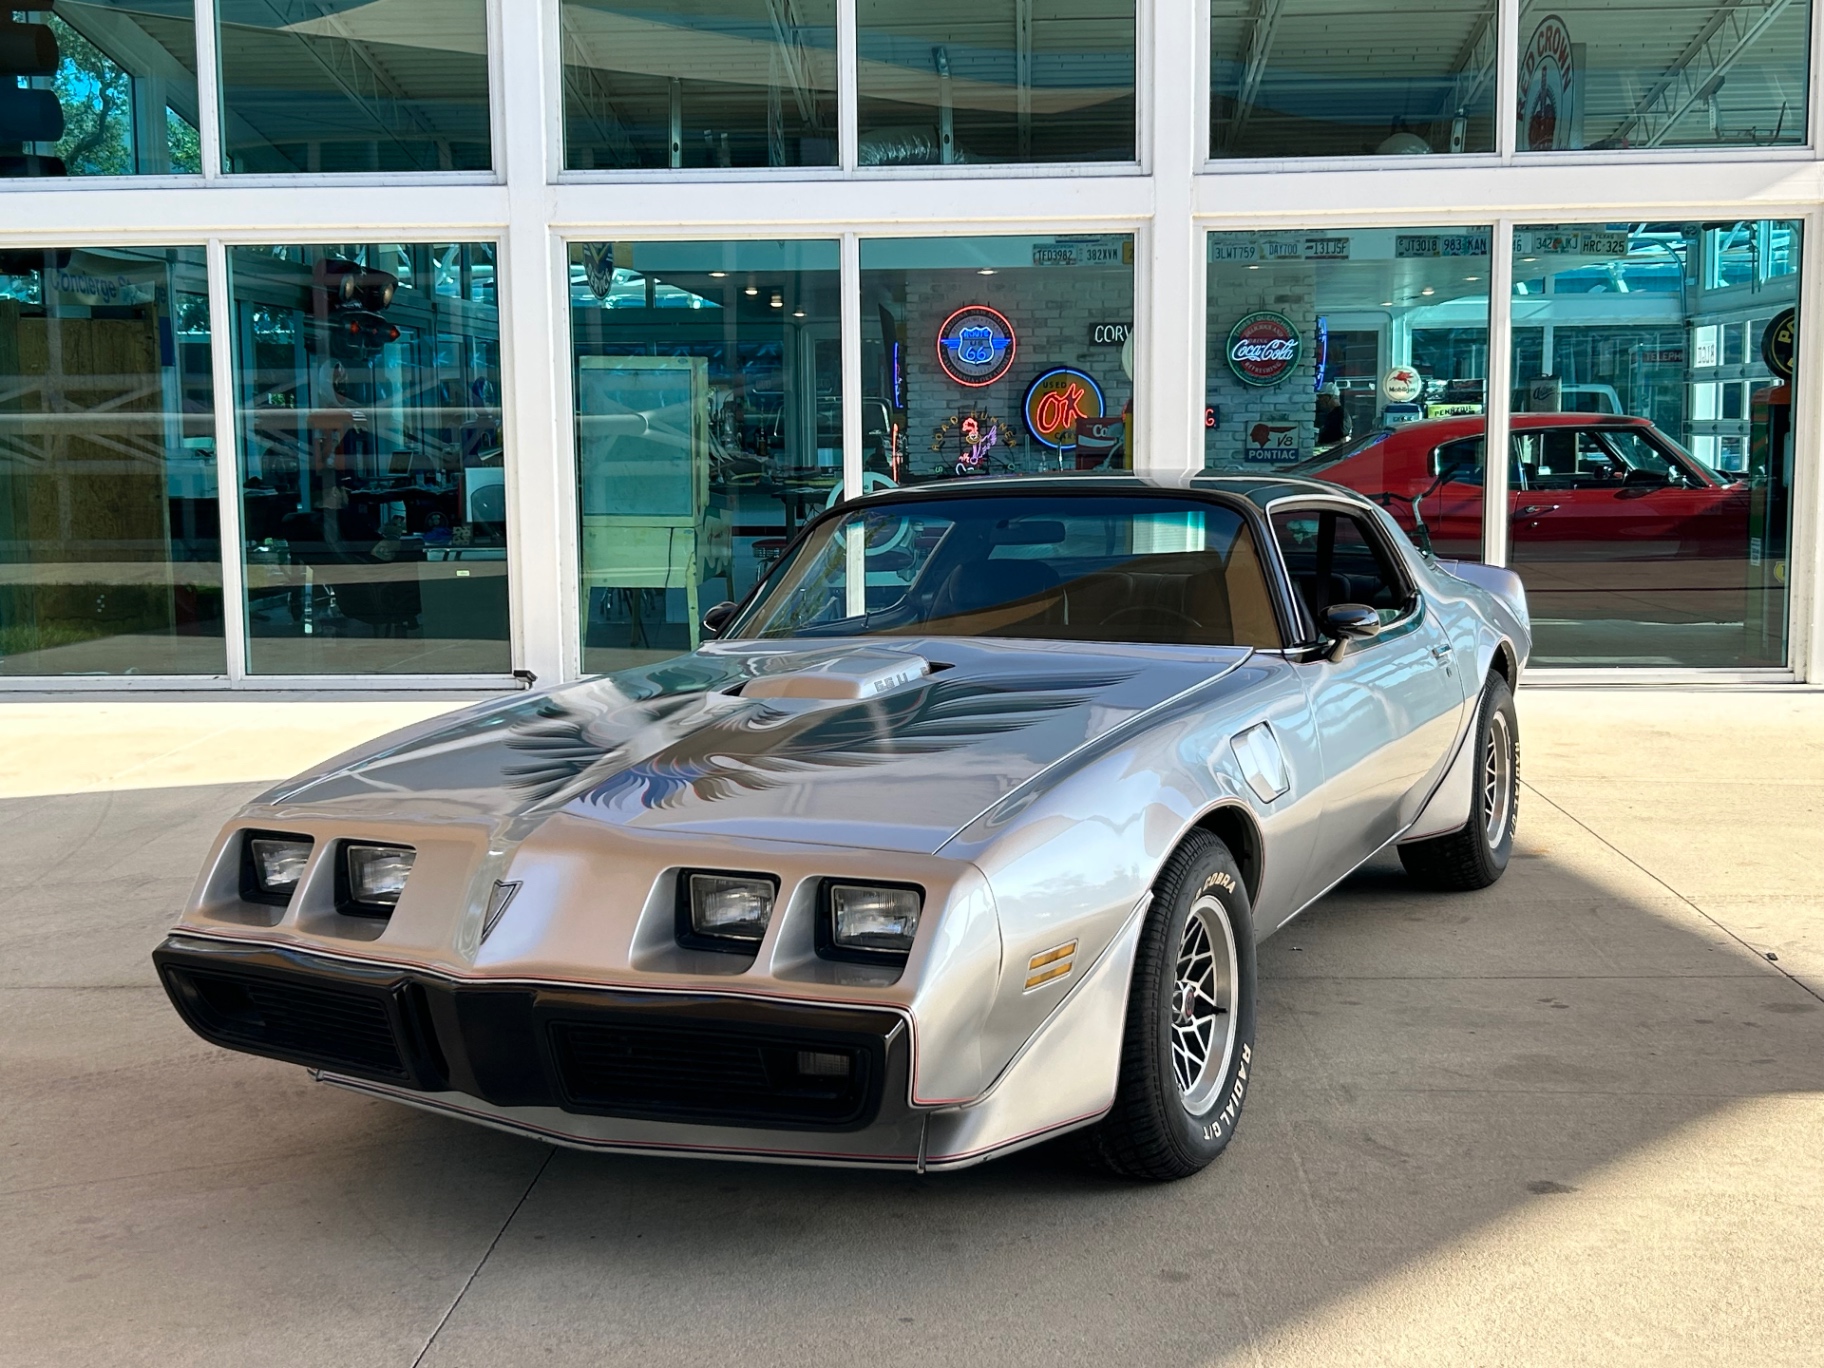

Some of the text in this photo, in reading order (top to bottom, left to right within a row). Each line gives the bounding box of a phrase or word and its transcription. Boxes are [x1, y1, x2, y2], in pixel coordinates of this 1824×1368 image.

[1537, 24, 1572, 94] CROWN
[1443, 239, 1462, 251] 983
[1215, 246, 1255, 259] 3LWT759
[963, 330, 989, 338] ROUTE
[966, 346, 987, 361] 66
[1231, 338, 1299, 361] Coca-Cola
[1645, 351, 1682, 362] TELEPH
[1042, 381, 1067, 389] USED
[1036, 383, 1088, 434] OK
[931, 412, 1017, 452] ROAD RUNNER
[1276, 433, 1294, 447] V8
[1248, 449, 1296, 460] PONTIAC
[1202, 871, 1236, 894] COBRA
[1219, 1042, 1252, 1126] RADIAL
